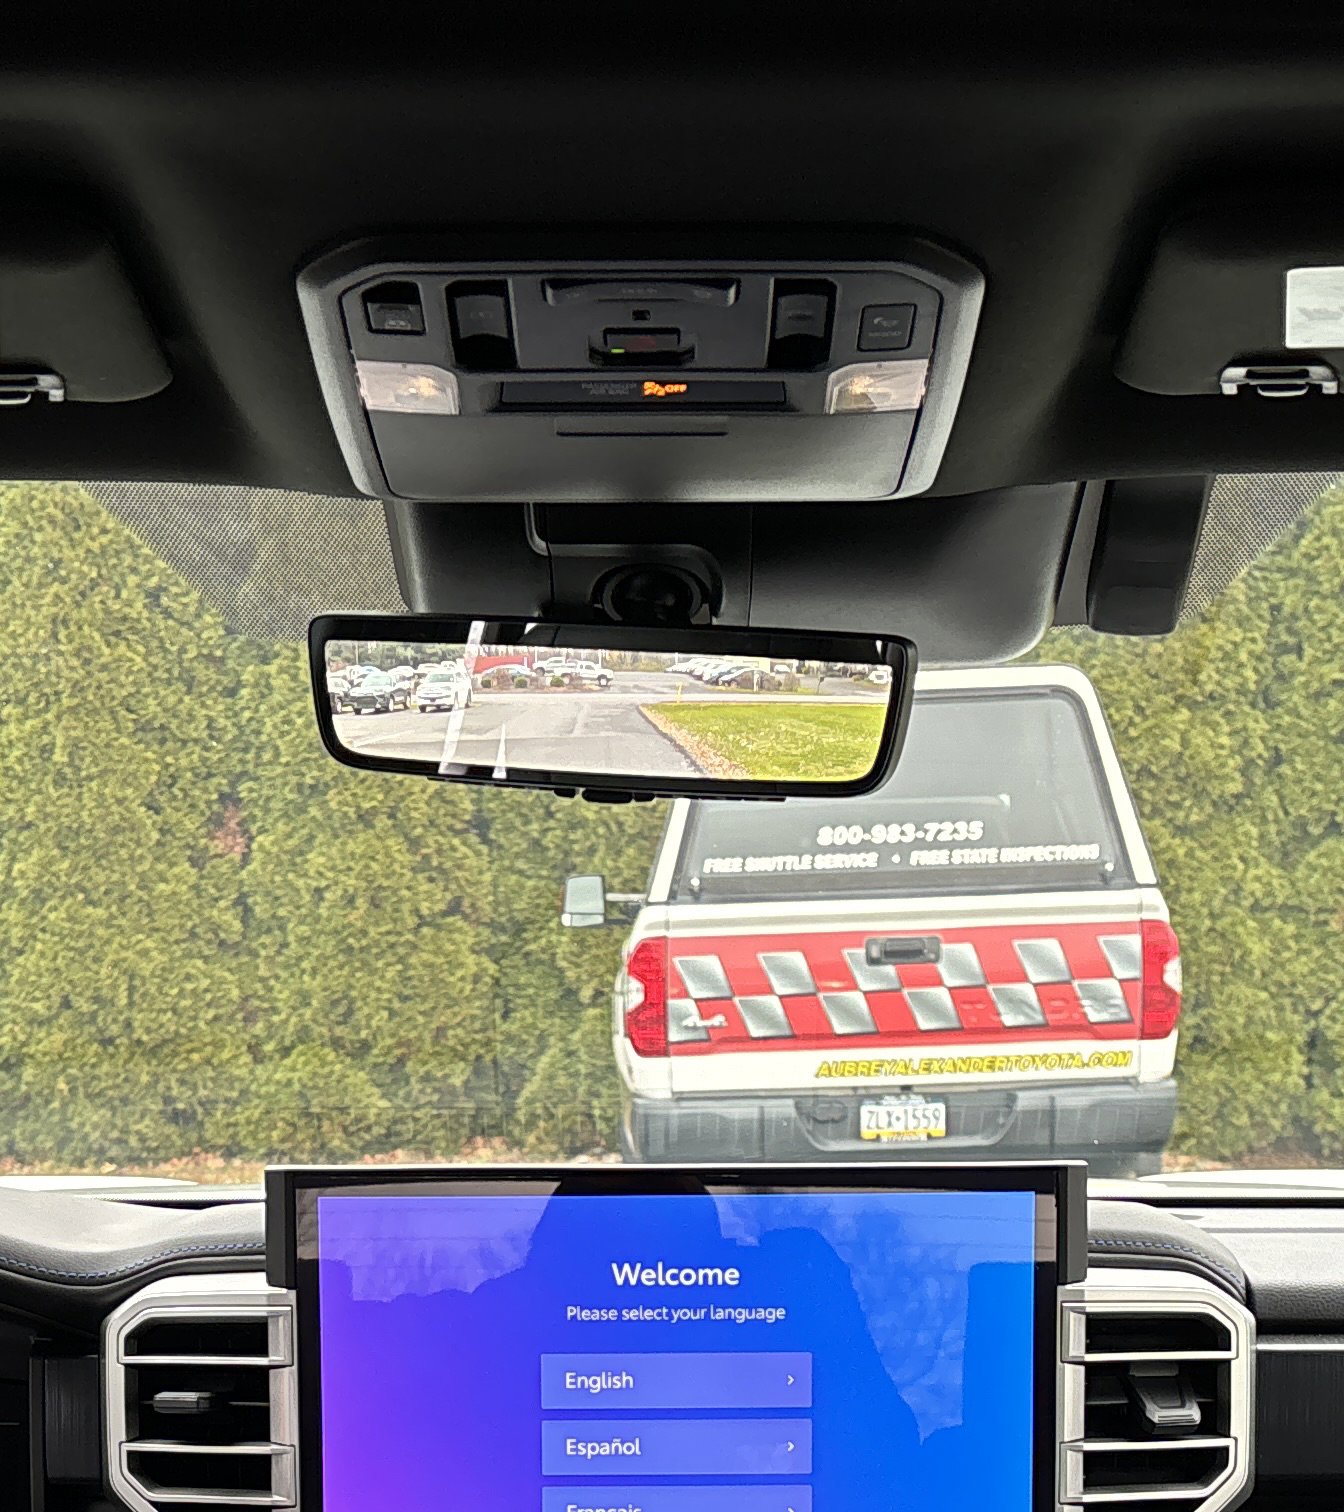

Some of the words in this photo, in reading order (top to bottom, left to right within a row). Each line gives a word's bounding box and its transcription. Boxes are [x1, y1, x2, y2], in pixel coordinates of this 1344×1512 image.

[664, 383, 687, 393] OFF
[703, 857, 744, 873] FREE
[744, 854, 813, 873] SHUTTLE
[814, 851, 879, 869] SERVICE
[909, 849, 950, 866] FREE
[951, 847, 998, 864] STATE
[999, 843, 1100, 863] INSPECTIONS
[815, 1050, 1133, 1079] AUBREYALEXANDERTOYOTA.COM
[611, 1261, 740, 1286] Welcome
[567, 1305, 618, 1321] Please
[621, 1305, 669, 1321] select
[670, 1307, 707, 1323] your
[709, 1304, 787, 1323] language
[565, 1371, 634, 1393] English
[565, 1437, 642, 1460] Español
